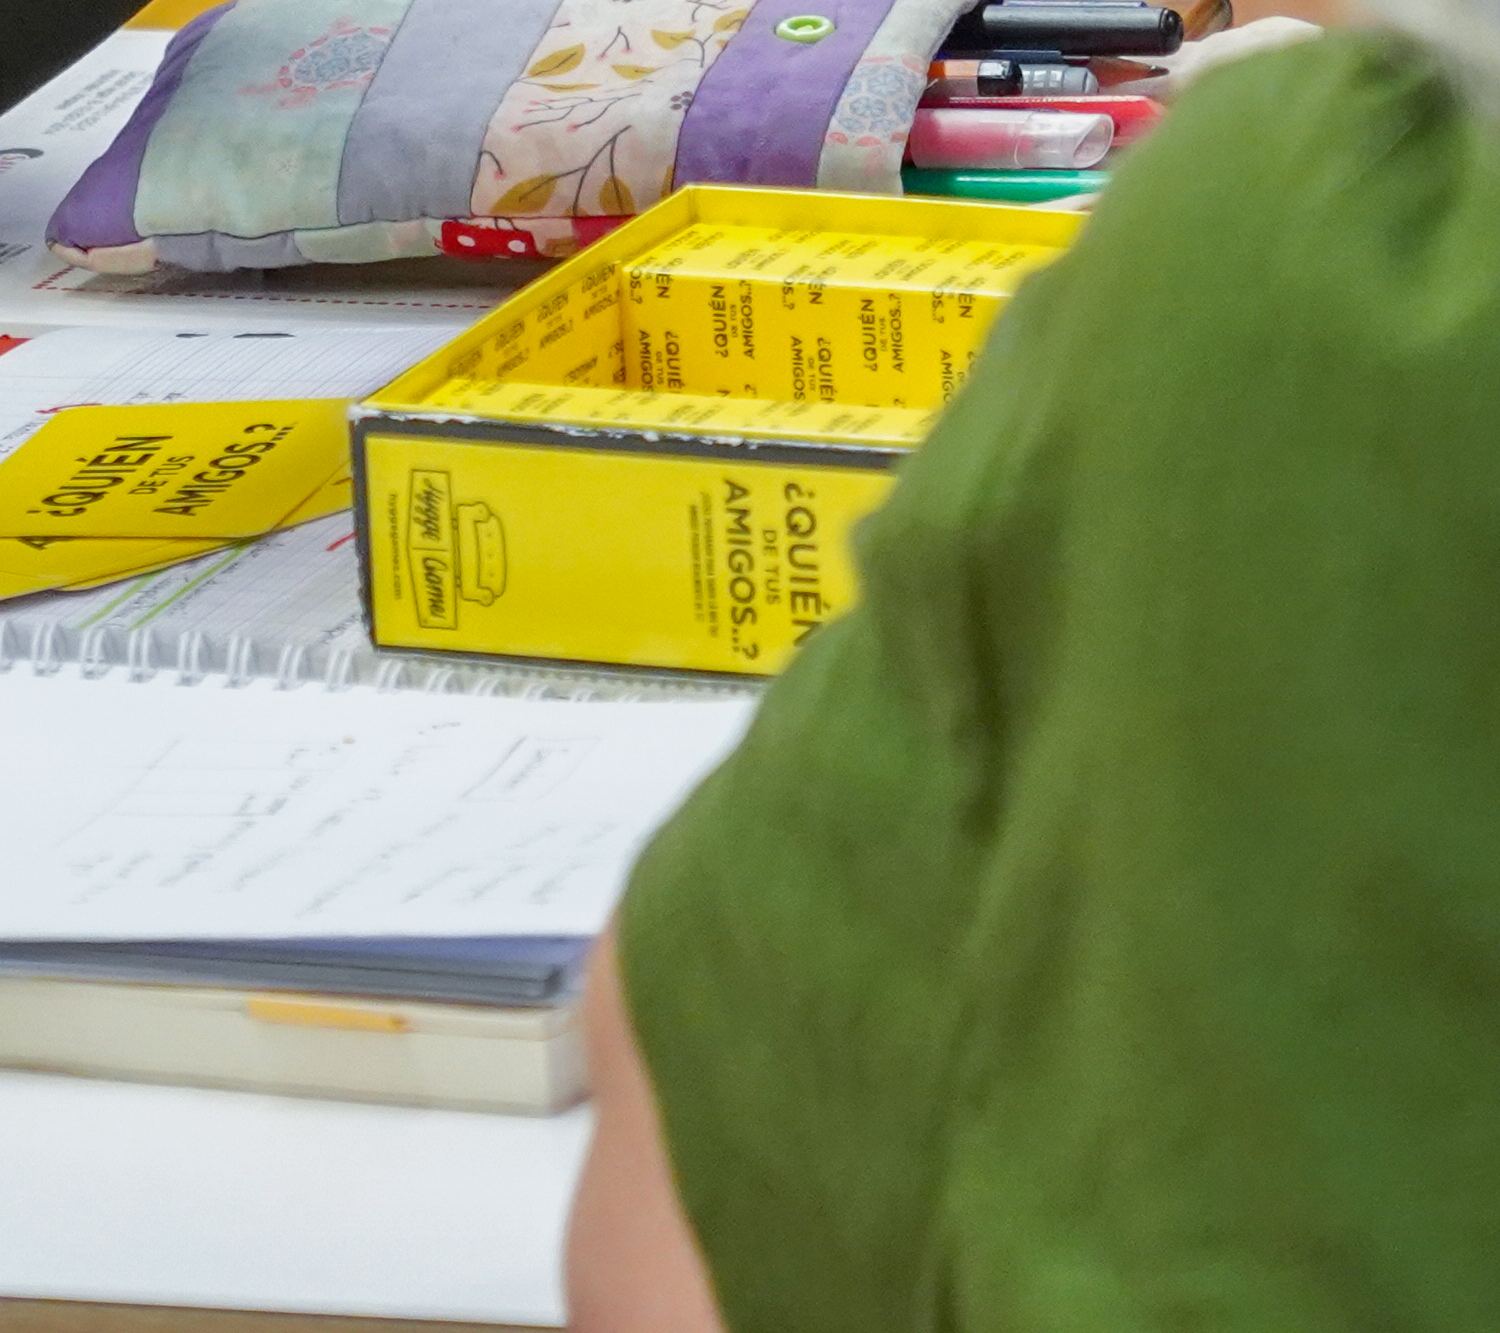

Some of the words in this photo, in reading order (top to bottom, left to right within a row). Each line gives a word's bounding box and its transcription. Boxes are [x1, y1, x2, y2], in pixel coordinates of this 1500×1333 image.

[708, 285, 729, 358] ¿QUIÉN
[857, 299, 878, 372] ¿QUIÉN
[665, 330, 685, 394] ¿QUIÉ
[26, 435, 174, 518] ¿QUIÉN
[127, 480, 169, 495] DE
[148, 455, 195, 478] TUS
[414, 477, 447, 543] Hygge
[763, 528, 779, 556] DE
[422, 556, 448, 620] Games
[765, 565, 781, 606] TUS
